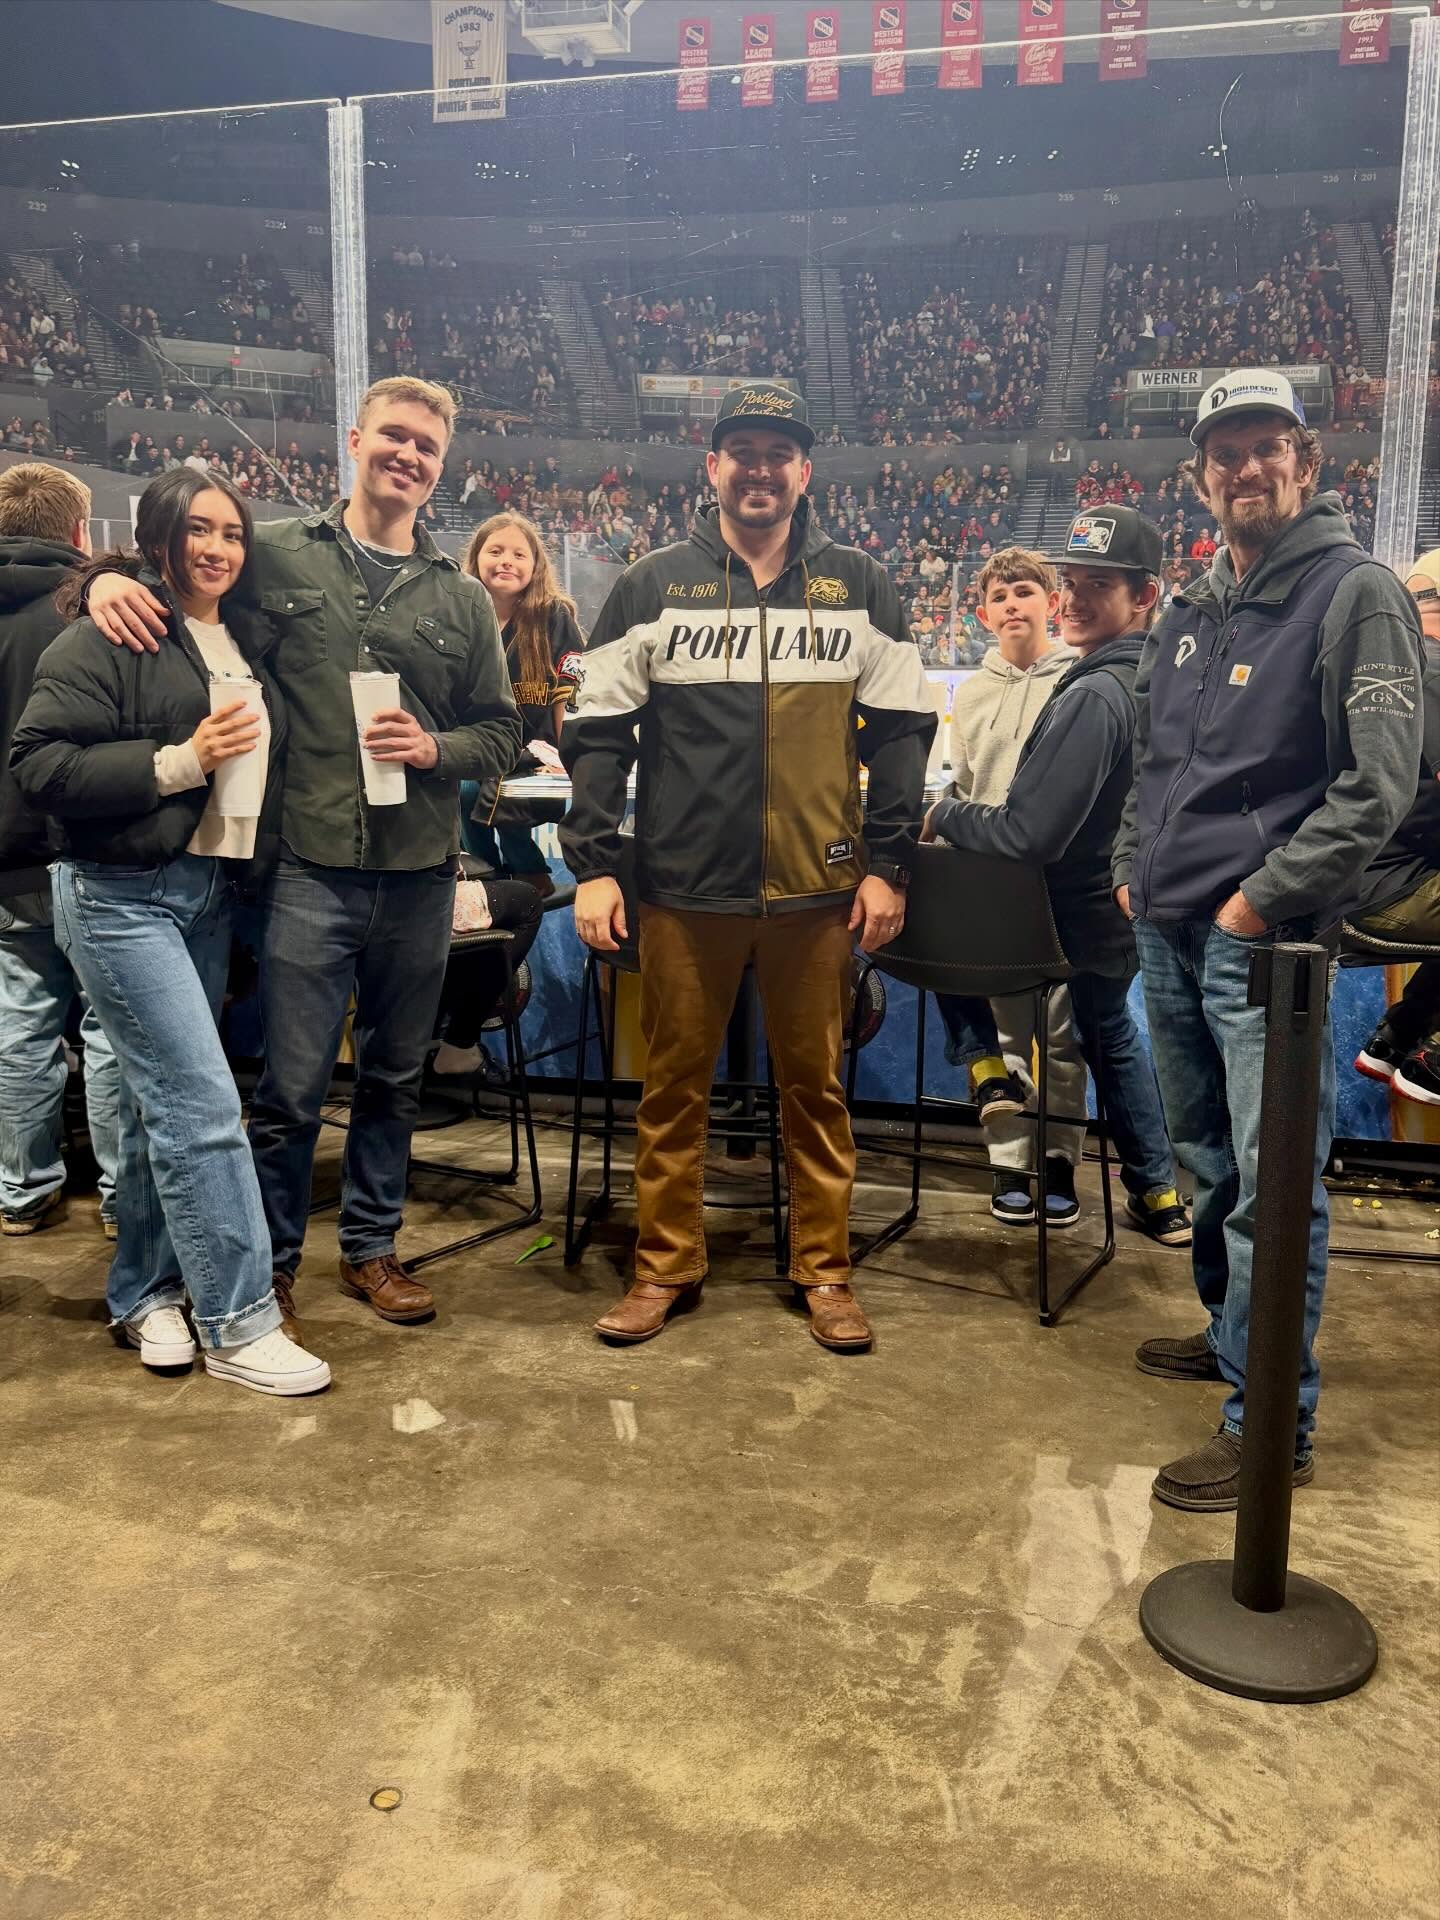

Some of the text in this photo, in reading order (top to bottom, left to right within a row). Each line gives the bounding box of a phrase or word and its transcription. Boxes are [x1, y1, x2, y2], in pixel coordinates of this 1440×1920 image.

[444, 6, 495, 25] CHAMPIONS
[459, 22, 480, 33] 1983
[875, 29, 903, 38] WESTERN
[875, 37, 903, 46] DIVISION
[745, 48, 772, 59] LEAGUE
[1142, 371, 1198, 386] WERNER
[1249, 385, 1278, 393] DESERT
[690, 581, 719, 599] 1976
[1387, 663, 1415, 675] STYLE
[1370, 691, 1393, 705] GS
